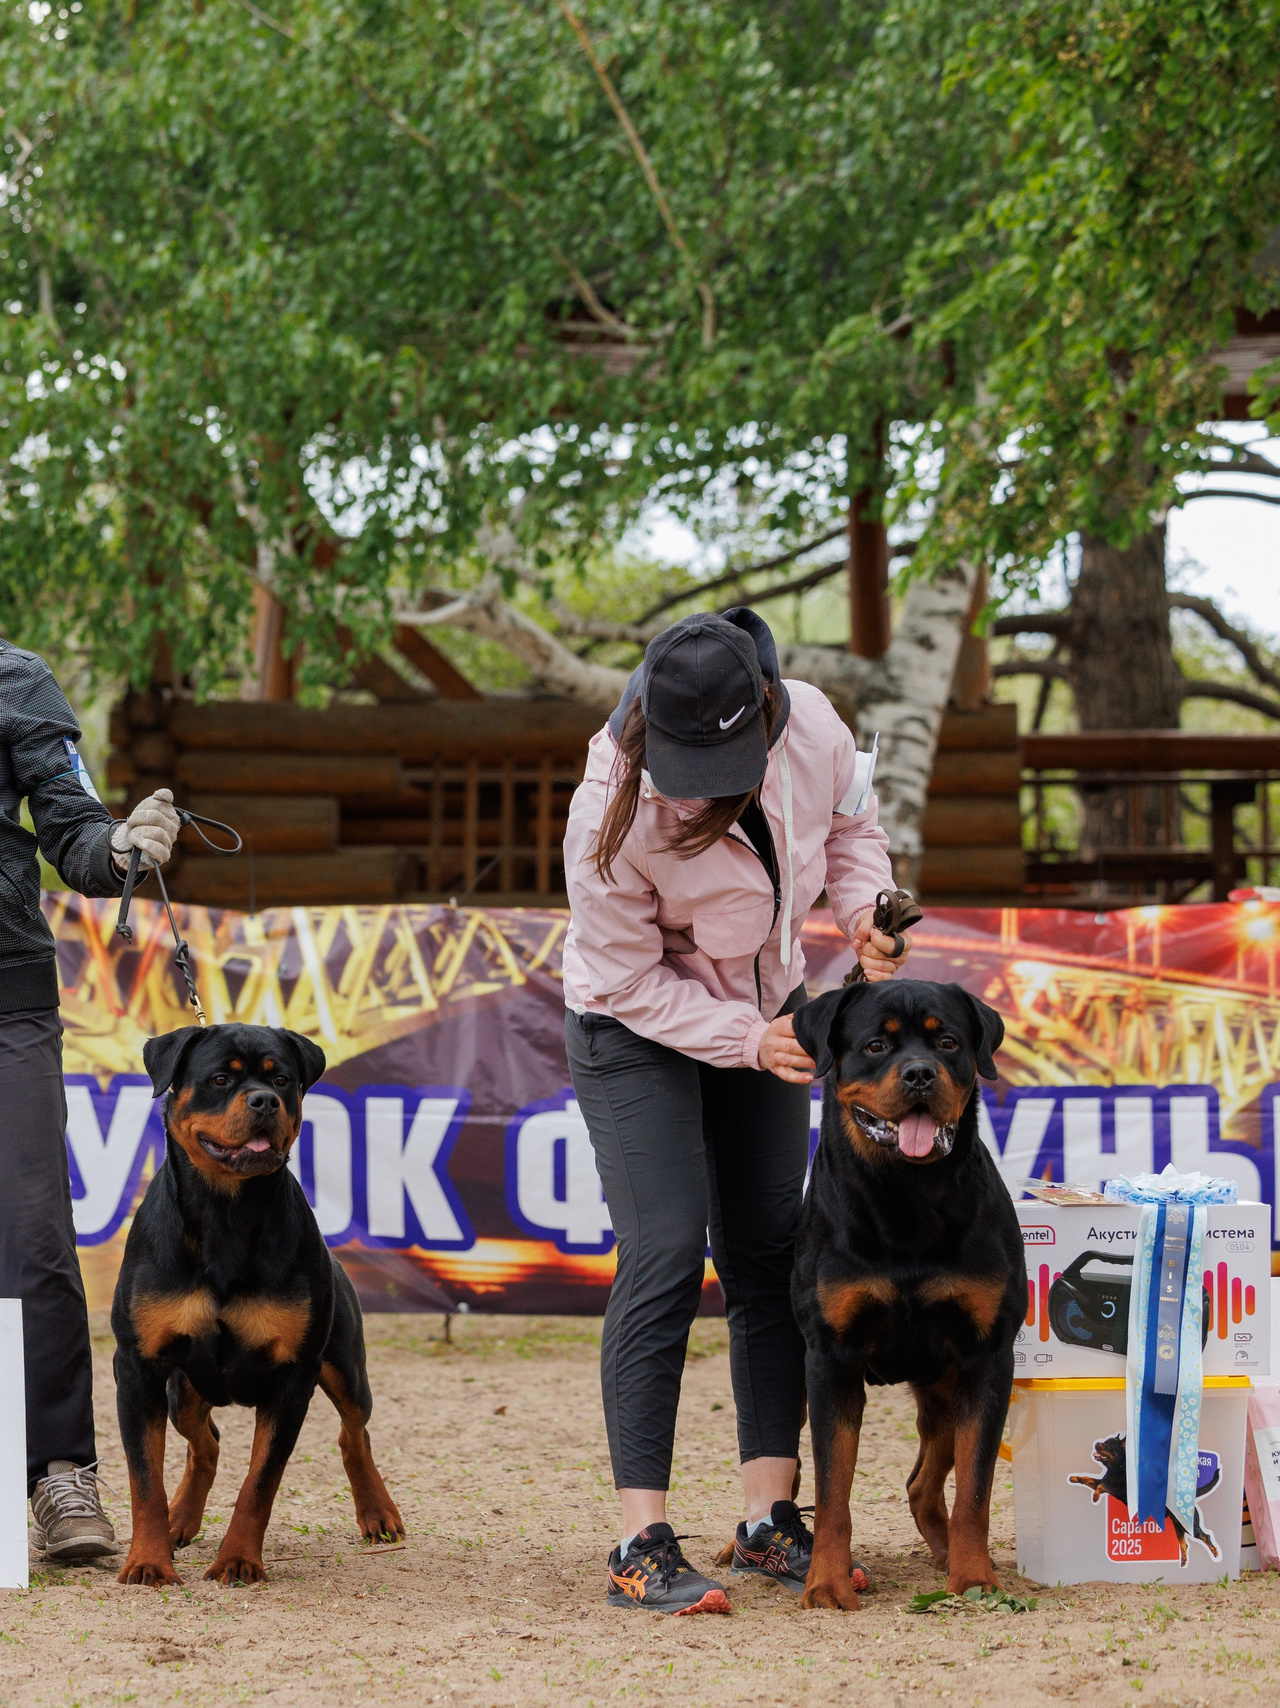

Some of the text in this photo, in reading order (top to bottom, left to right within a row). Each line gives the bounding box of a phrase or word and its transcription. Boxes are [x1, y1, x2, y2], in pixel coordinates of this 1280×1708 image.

[1022, 1230, 1049, 1240] entel
[1087, 1227, 1137, 1243] Акусти
[1111, 1539, 1142, 1555] 2025
